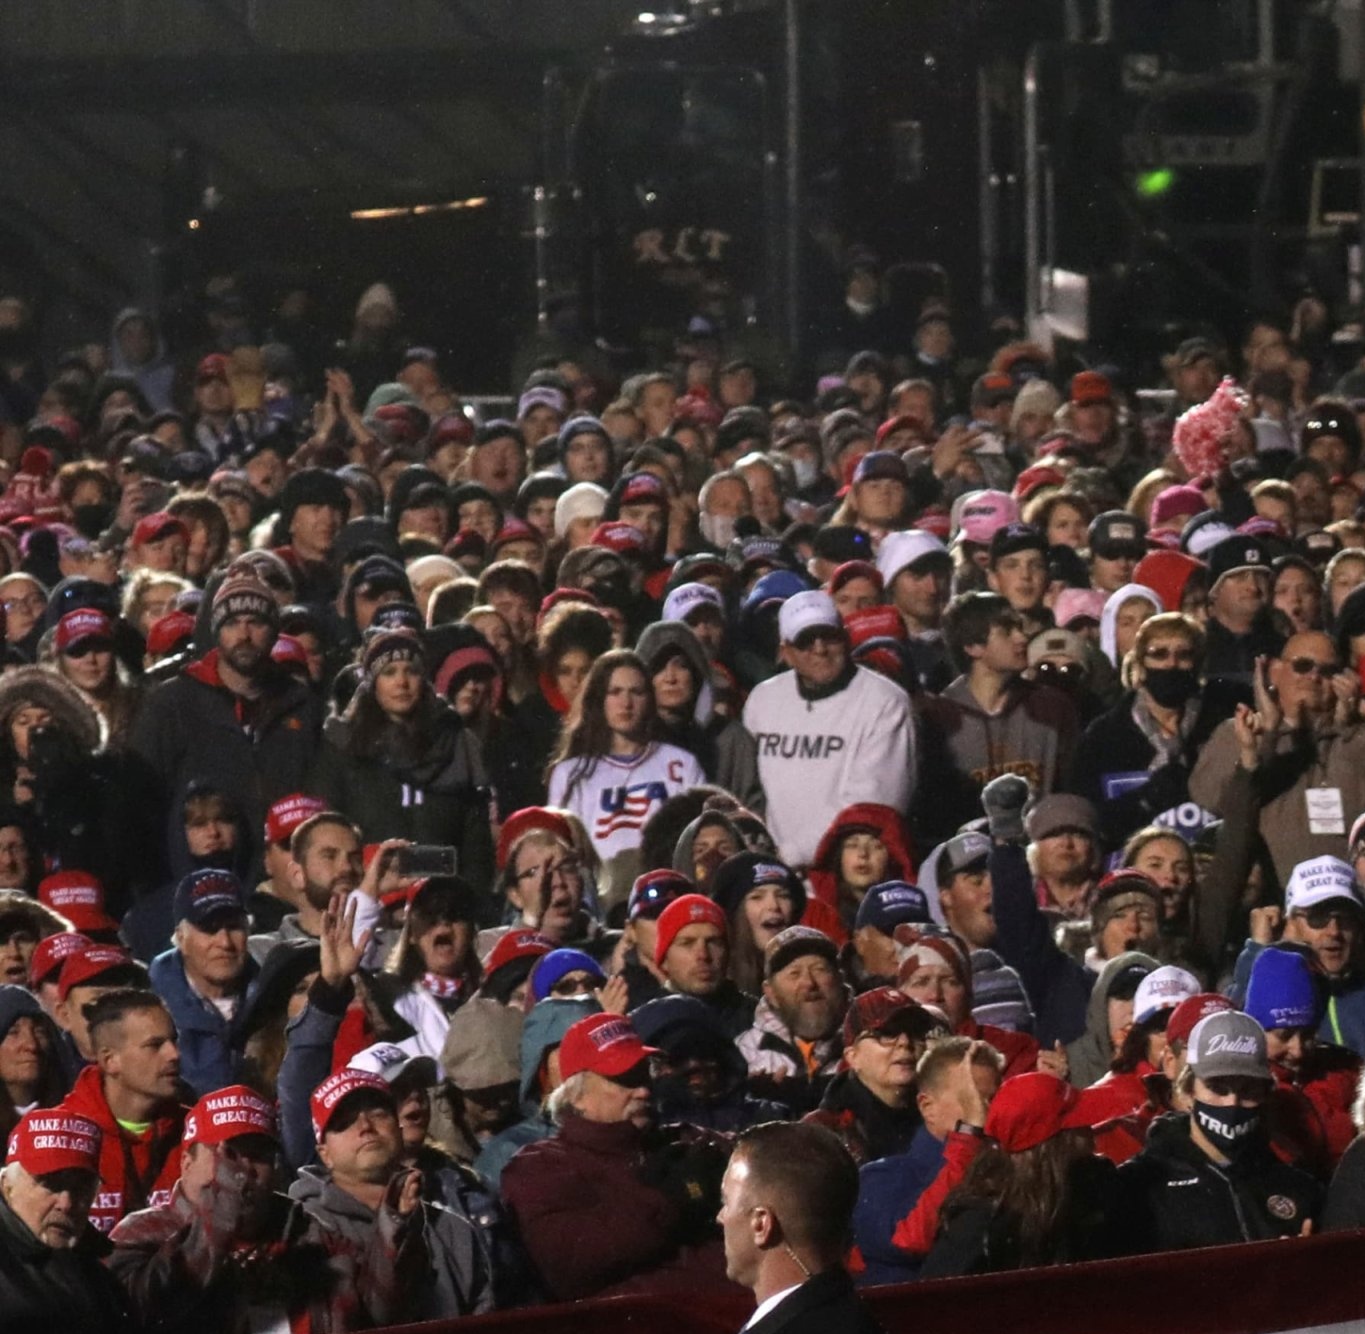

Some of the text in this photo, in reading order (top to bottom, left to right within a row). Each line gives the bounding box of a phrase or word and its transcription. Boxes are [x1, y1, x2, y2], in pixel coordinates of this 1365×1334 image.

[756, 732, 845, 759] TRUMP
[667, 760, 684, 783] C
[206, 1095, 237, 1112] MAKE
[29, 1119, 60, 1133] MAKE
[213, 1110, 248, 1127] GREAT
[33, 1134, 68, 1150] GREAT
